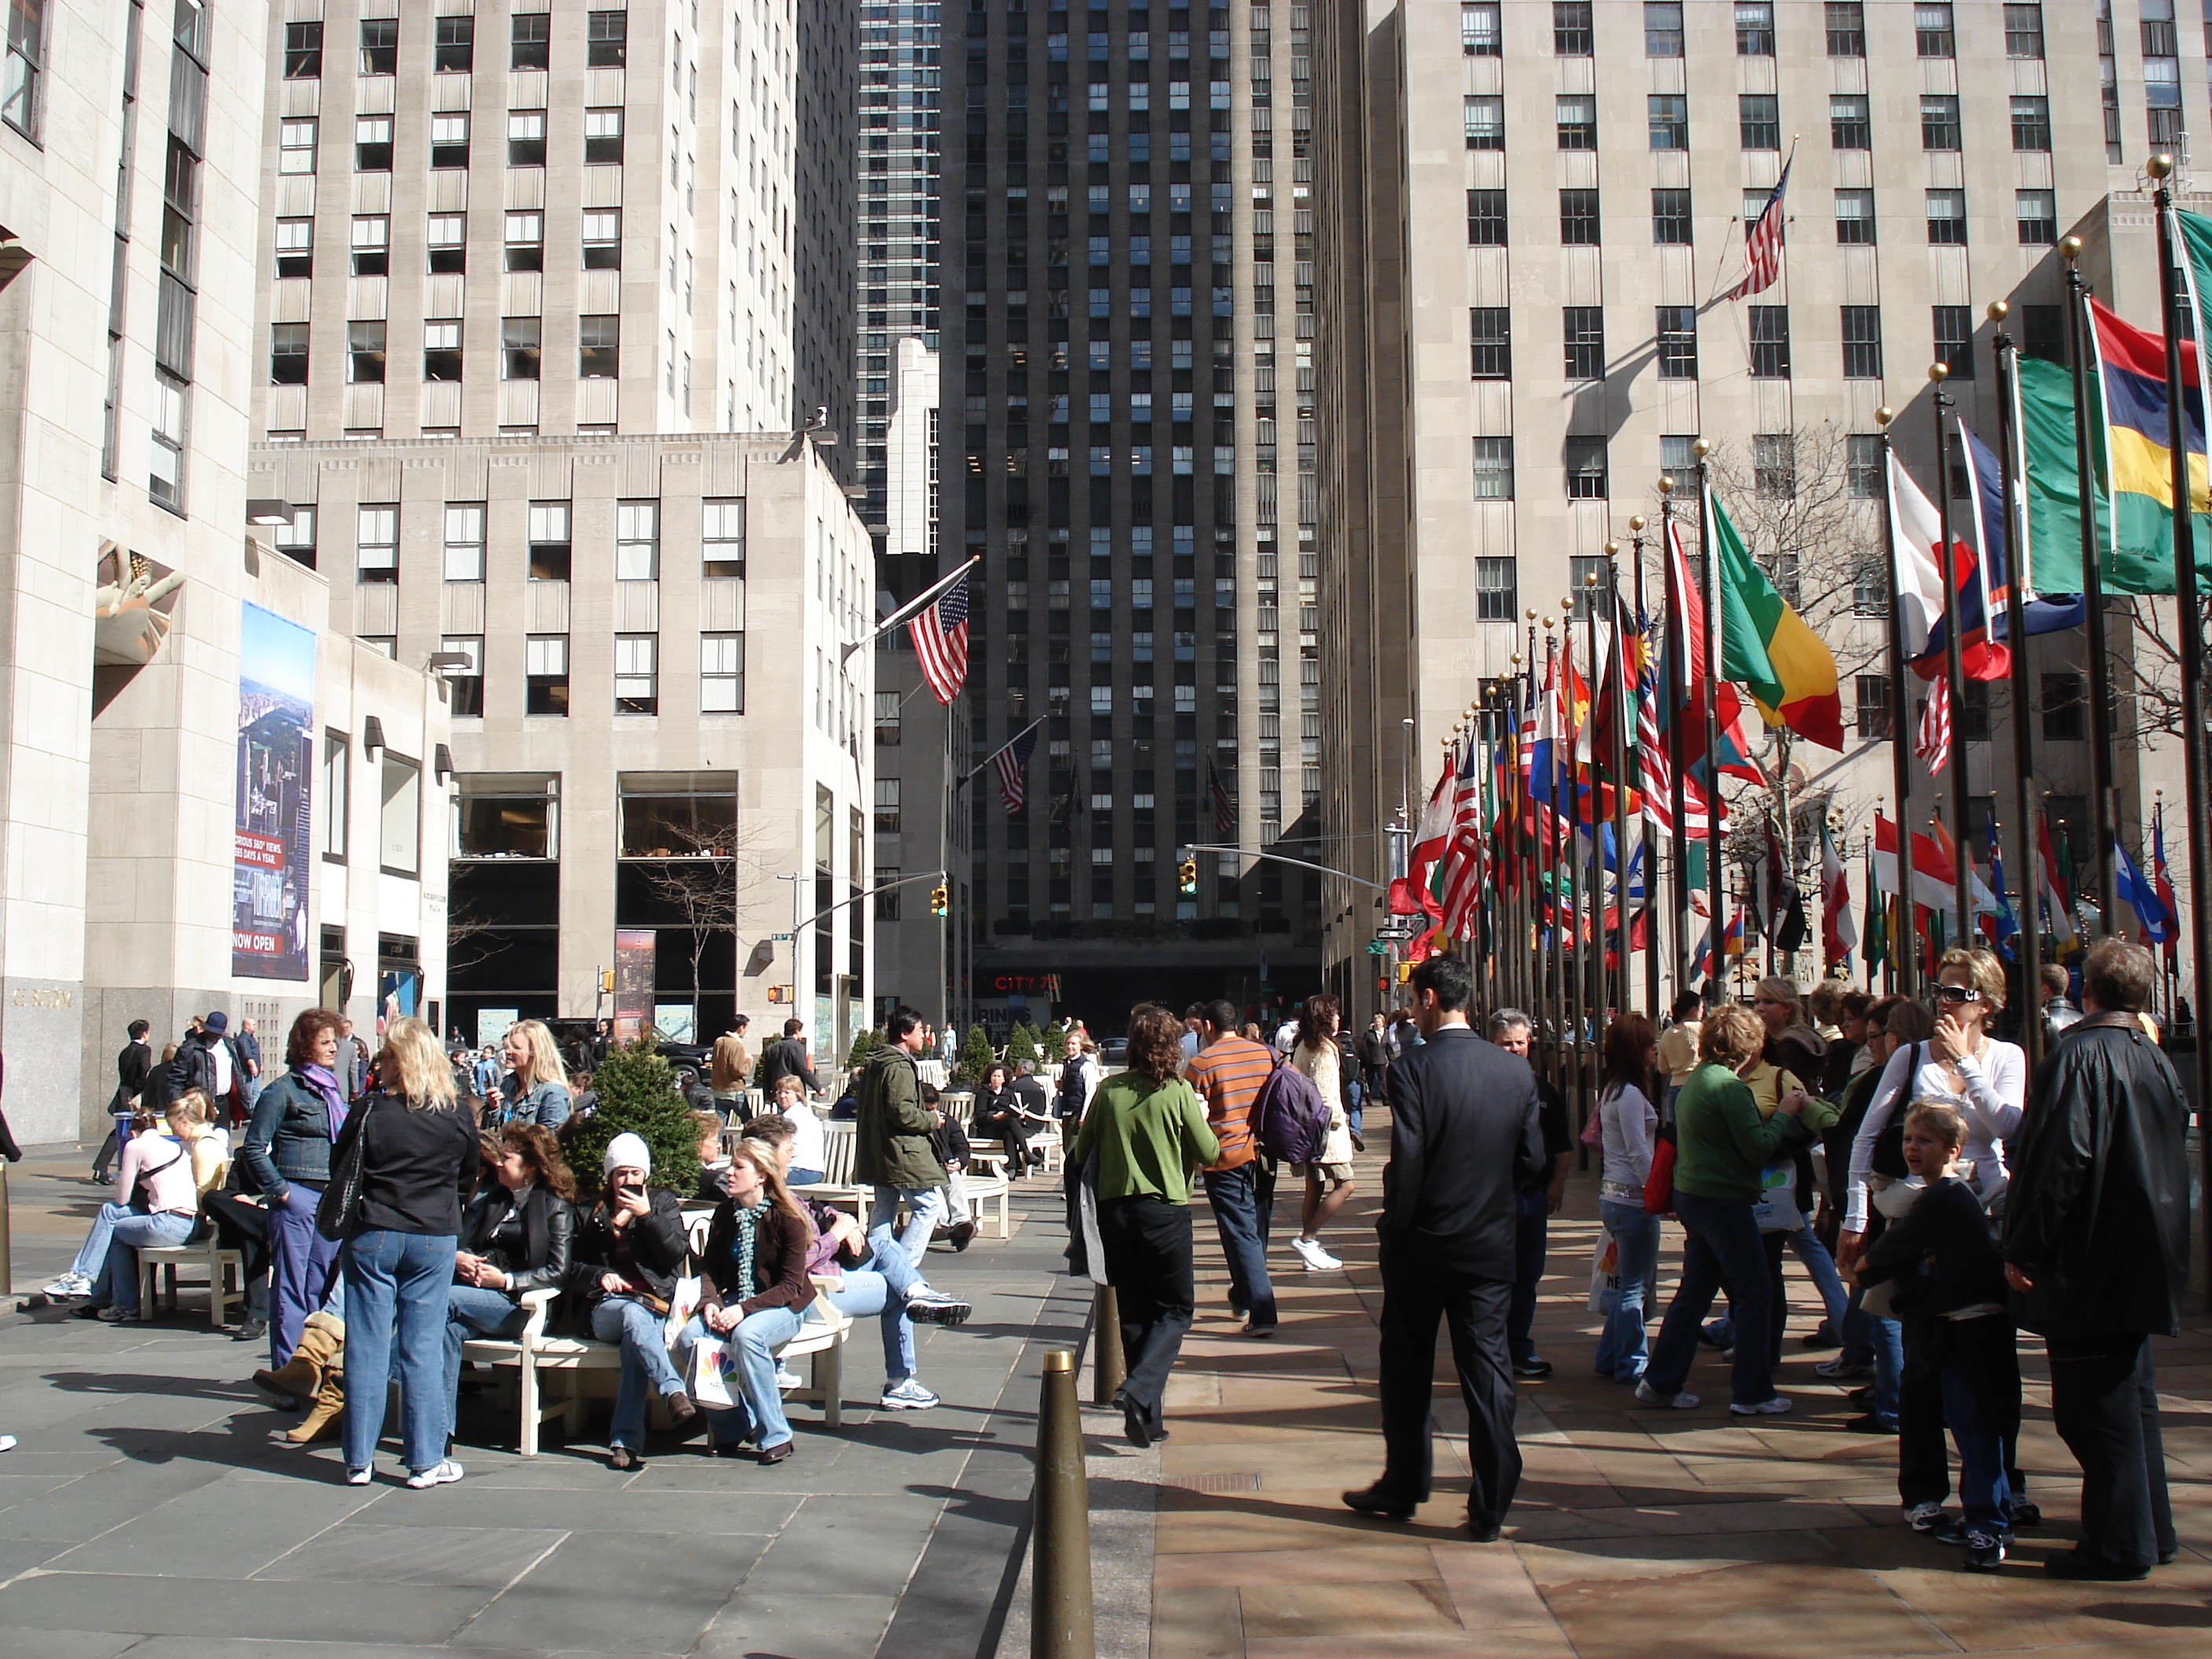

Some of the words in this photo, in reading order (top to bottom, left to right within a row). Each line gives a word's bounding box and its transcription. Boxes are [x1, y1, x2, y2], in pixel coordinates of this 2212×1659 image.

[257, 851, 262, 862] A
[233, 932, 252, 949] NOW
[253, 935, 275, 951] OPEN
[994, 976, 1035, 990] CITY
